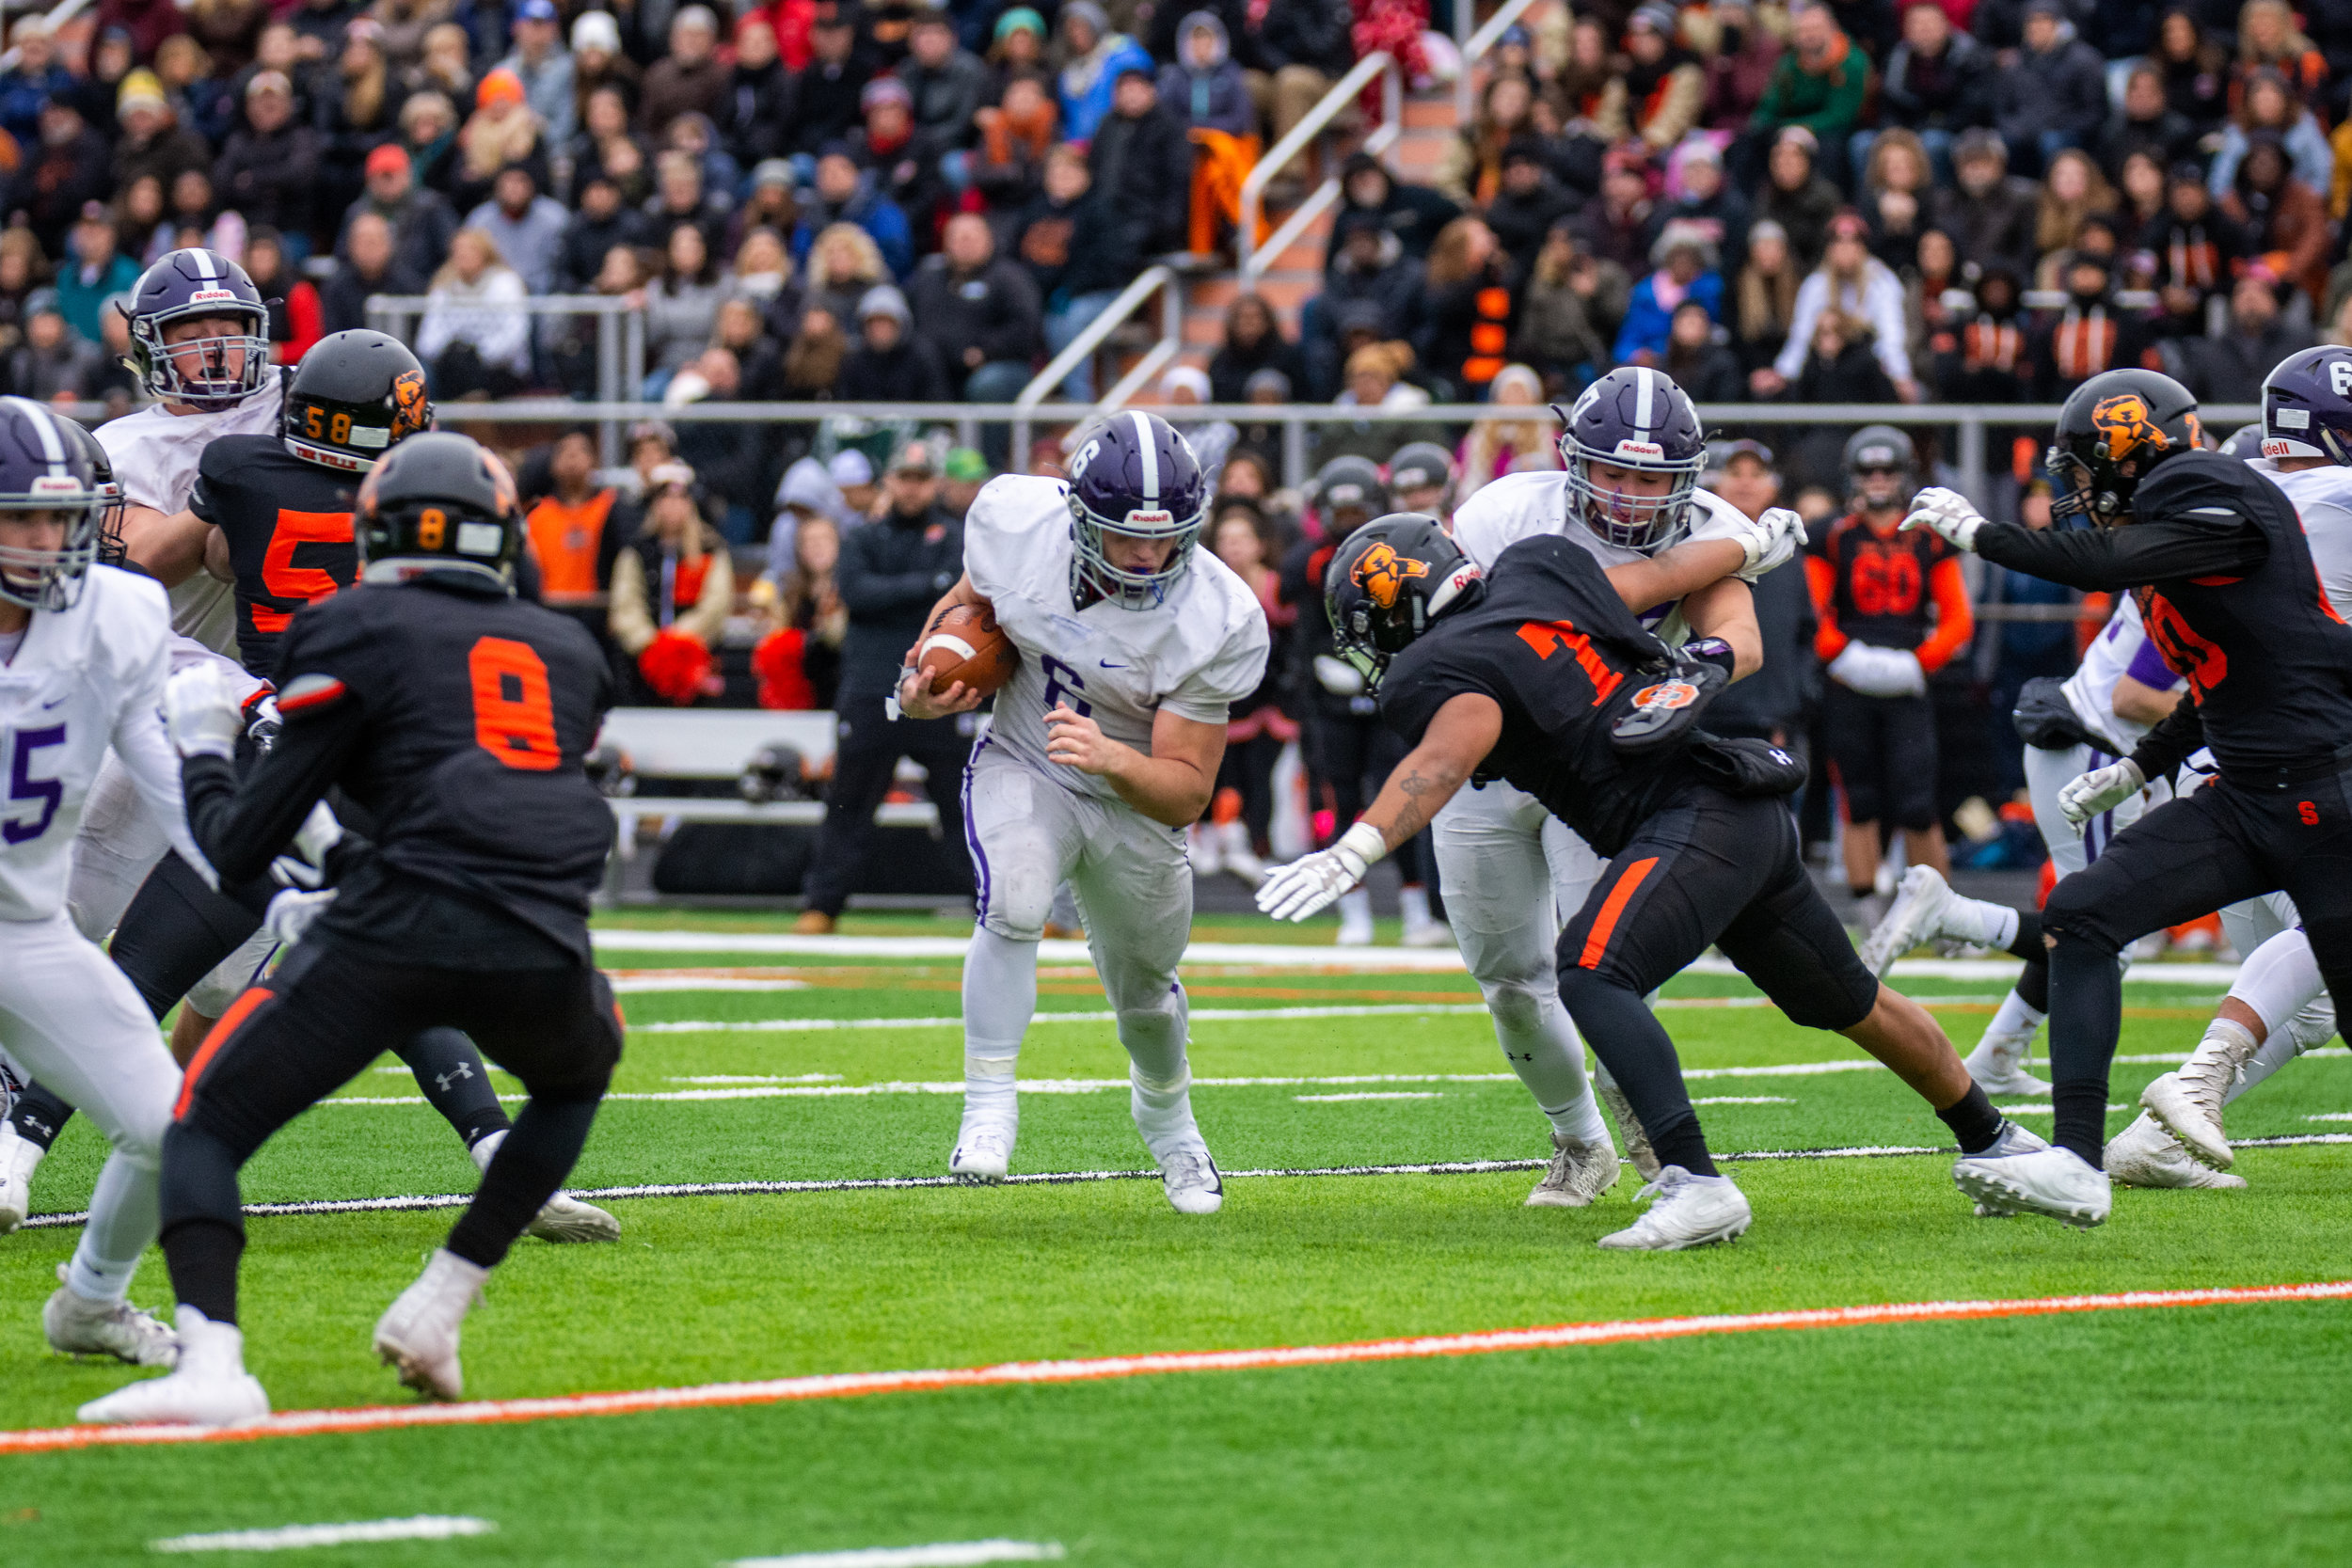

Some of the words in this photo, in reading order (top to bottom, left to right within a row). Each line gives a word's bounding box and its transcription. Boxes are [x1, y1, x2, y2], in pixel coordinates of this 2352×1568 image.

[195, 291, 230, 300] Riddell
[2329, 361, 2352, 396] 6
[306, 405, 351, 444] 58
[1072, 439, 1101, 480] 6
[419, 508, 447, 550] 8
[1133, 514, 1168, 522] Riddell
[250, 508, 364, 633] 5
[468, 635, 563, 771] 8
[2, 721, 67, 845] 5
[2297, 801, 2319, 825] S
